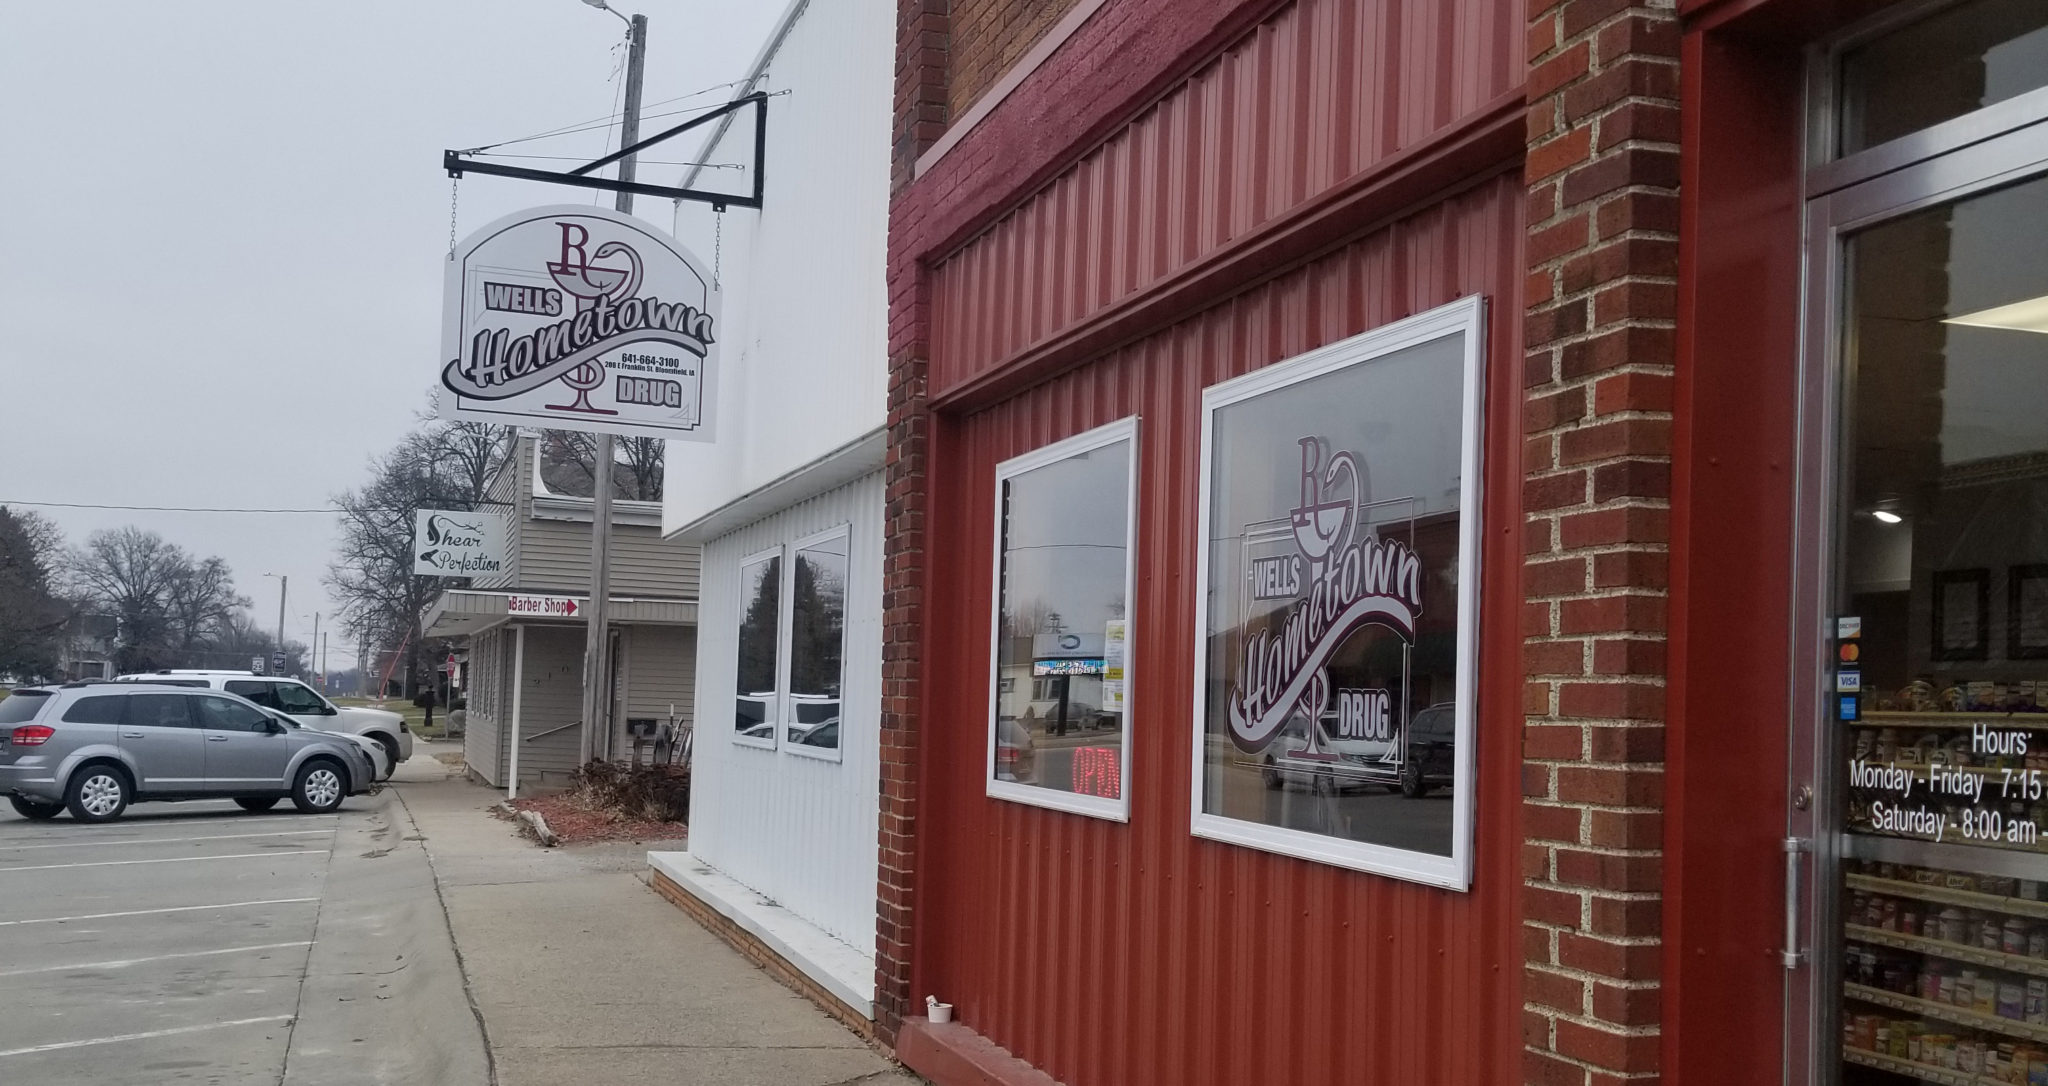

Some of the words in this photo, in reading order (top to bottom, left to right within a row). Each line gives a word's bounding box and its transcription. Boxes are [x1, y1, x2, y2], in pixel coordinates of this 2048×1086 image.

[484, 281, 562, 317] WELLS
[466, 294, 715, 387] Hometown
[621, 363, 646, 371] Franklin
[622, 353, 680, 368] 641-664-3100
[616, 375, 682, 408] DRUG
[423, 514, 483, 547] Shear
[438, 550, 500, 575] Perfection
[1252, 553, 1301, 600] WELLS
[511, 596, 541, 612] Barber
[544, 597, 567, 616] Shop
[1240, 535, 1423, 728] Hometown
[1841, 676, 1858, 686] VISA
[1338, 688, 1391, 742] DRUG
[1072, 746, 1120, 799] OPEN
[1850, 760, 1914, 798] Monday
[1930, 764, 1985, 804] Friday
[2001, 767, 2042, 800] 7:15
[1872, 801, 1946, 842] Saturday
[1962, 808, 2002, 841] 8:00
[2007, 819, 2037, 844] am
